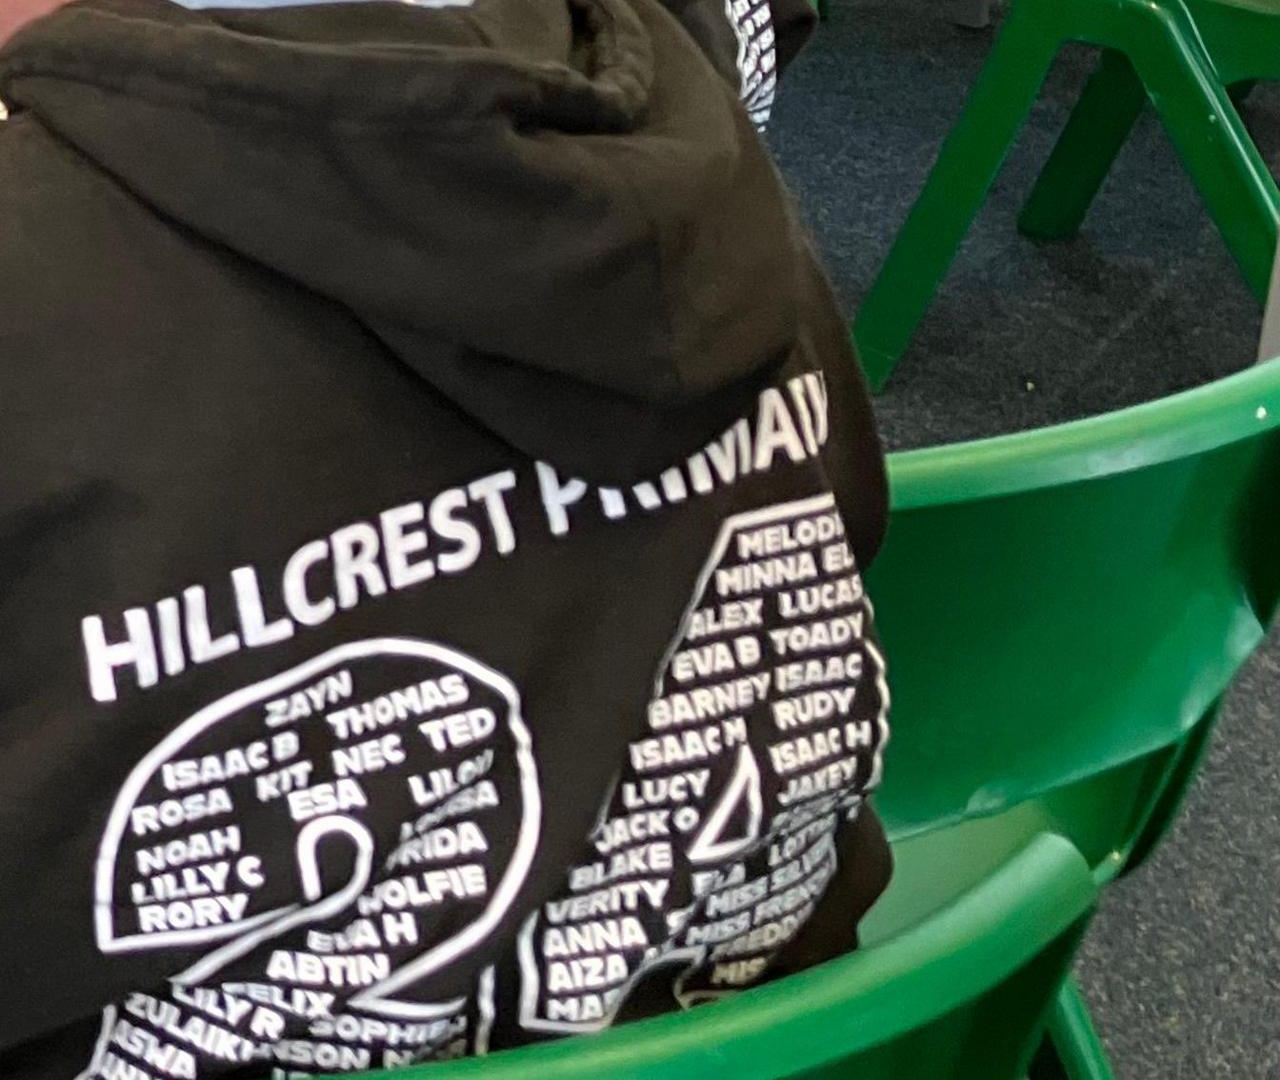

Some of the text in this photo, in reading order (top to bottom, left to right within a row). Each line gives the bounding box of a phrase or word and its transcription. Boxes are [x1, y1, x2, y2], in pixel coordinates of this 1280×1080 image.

[81, 469, 517, 702] HILLCREST
[715, 551, 818, 597] MINNA
[686, 574, 864, 641] ALEX LUCAS
[671, 612, 864, 683] EVA B TOADY
[265, 670, 353, 728] ZAYN
[647, 652, 863, 730] BARNEY ISAAC
[771, 687, 856, 731] RUDY
[162, 673, 470, 792] ISAAC B THOMAS
[628, 726, 723, 771] ISAAC
[767, 727, 844, 774] ISAAC
[844, 720, 872, 749] H
[131, 706, 496, 836] ROSA KIT NEC TED
[621, 769, 711, 808] LUCY
[287, 777, 368, 822] ESA
[135, 824, 241, 876] NOAH
[593, 809, 671, 854] JACK
[130, 860, 230, 905] LILLY
[236, 855, 265, 888] C
[569, 841, 673, 893] BLAKE
[137, 863, 487, 934] RORY WOLFIE
[545, 878, 670, 924] VERITY
[381, 911, 419, 946] H
[544, 917, 647, 958] ANNA
[266, 950, 391, 987] ABTIN
[547, 953, 629, 993] AIZA
[249, 1005, 286, 1040] R
